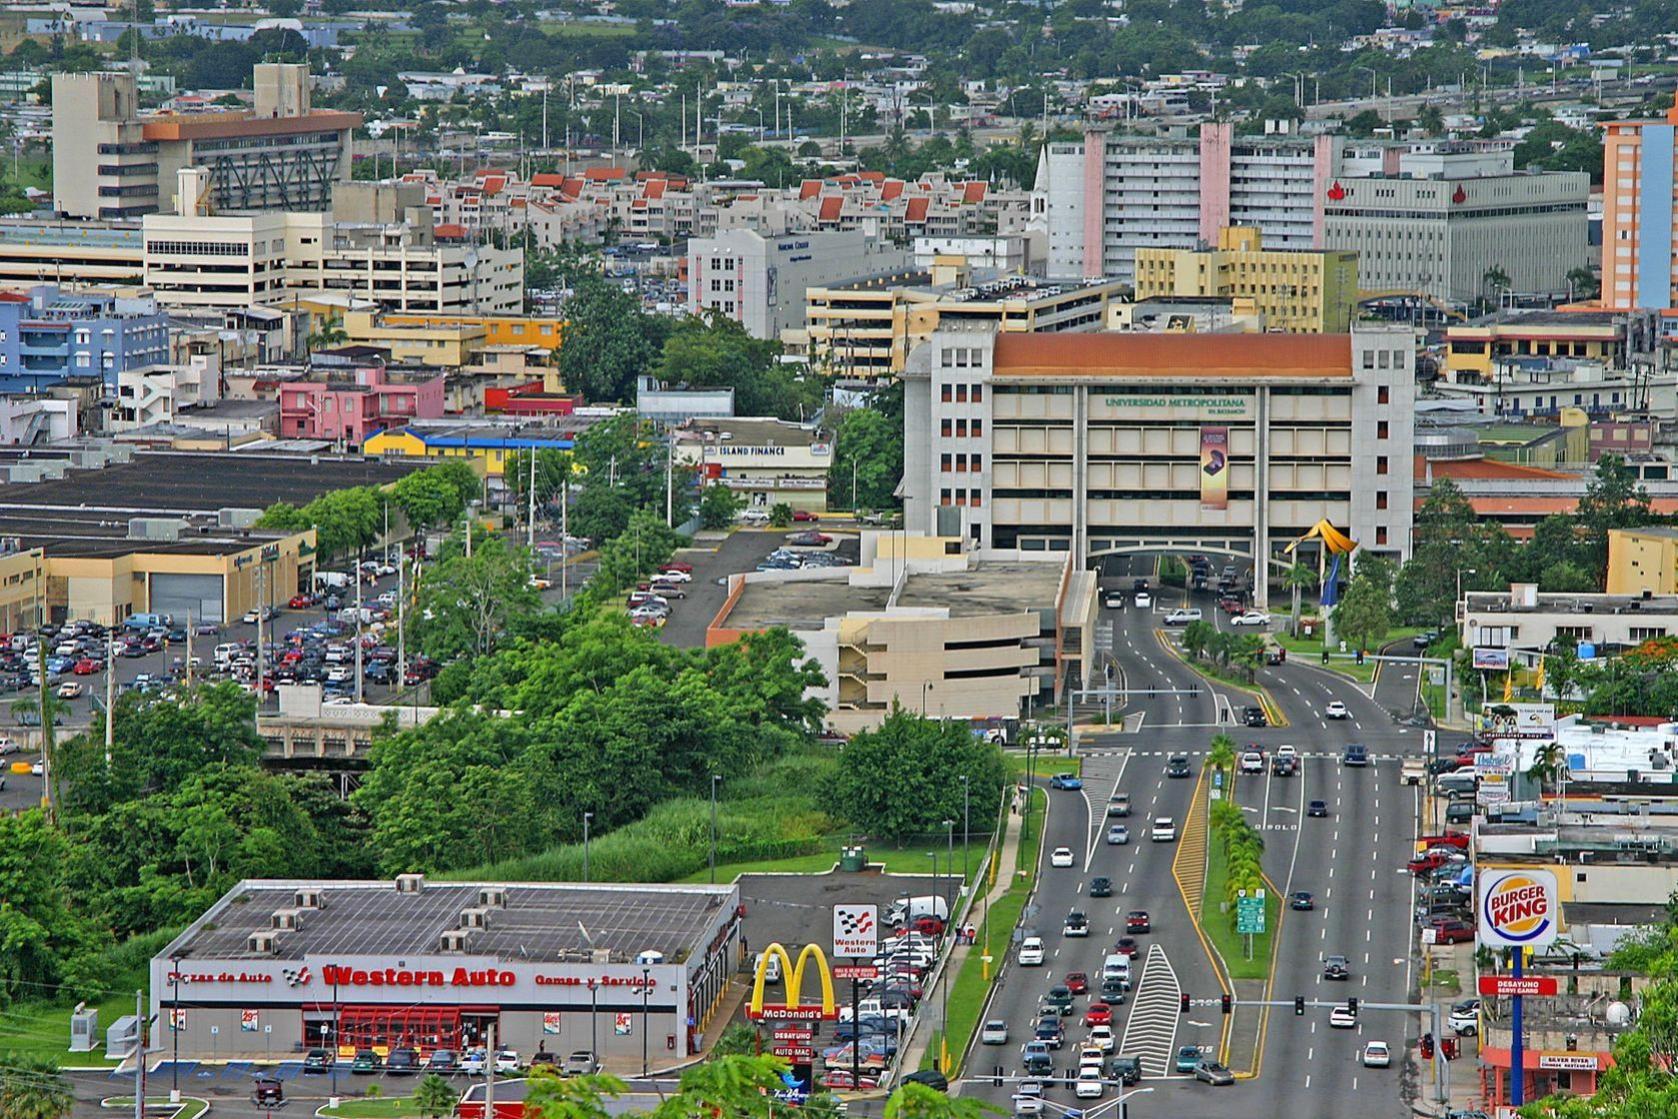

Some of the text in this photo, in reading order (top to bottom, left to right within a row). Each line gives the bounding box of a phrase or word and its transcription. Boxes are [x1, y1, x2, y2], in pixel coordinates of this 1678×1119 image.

[1105, 398, 1246, 407] UNIVERSIDAD METROPOLITANA
[720, 446, 748, 456] ISLAND
[750, 446, 784, 456] FINANCE
[1492, 886, 1547, 928] BURGER KING
[218, 972, 235, 982] de
[238, 972, 272, 983] Auto
[322, 966, 516, 986] Western Auto
[535, 975, 580, 986] Gomas
[586, 977, 595, 990] y
[763, 1010, 822, 1018] McDonald's
[786, 1088, 800, 1097] 24
